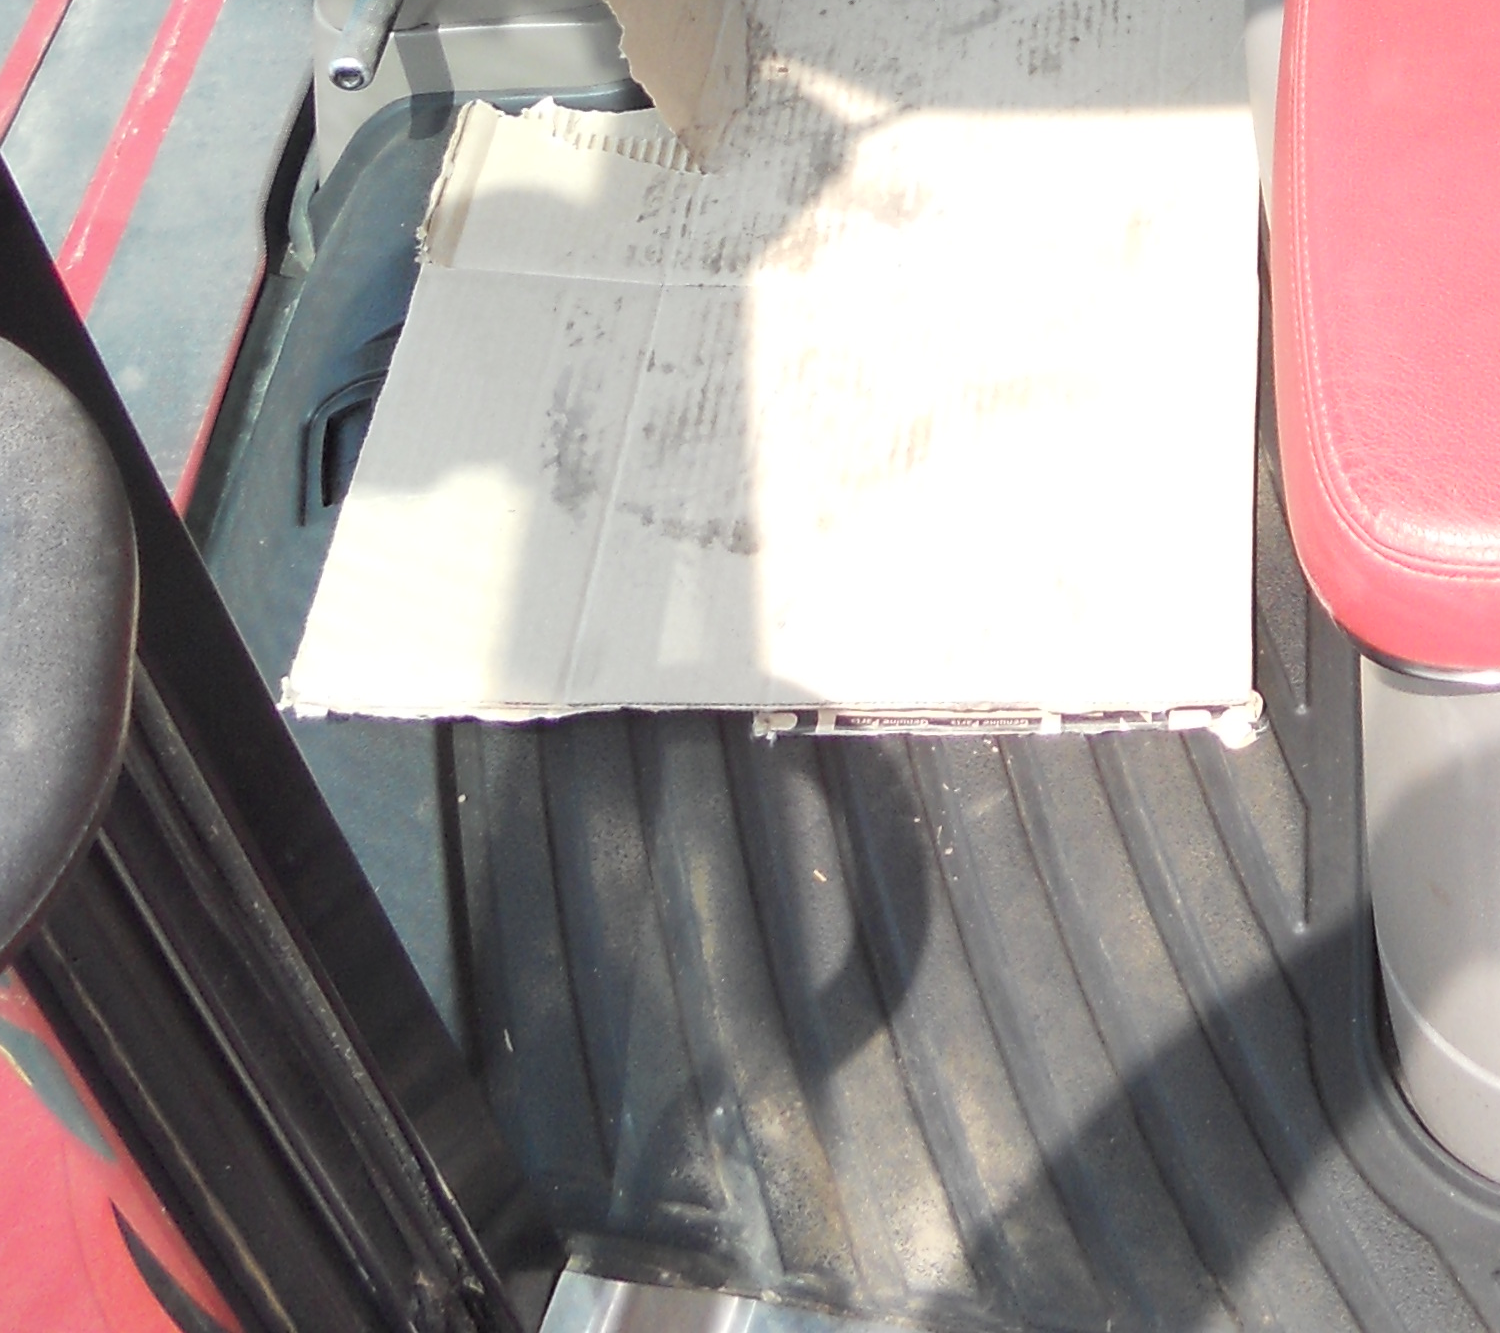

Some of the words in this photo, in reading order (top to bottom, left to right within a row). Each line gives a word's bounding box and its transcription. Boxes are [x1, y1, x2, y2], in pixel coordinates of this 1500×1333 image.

[850, 718, 880, 728] Parts
[883, 718, 929, 728] Genuine
[950, 719, 980, 728] Parts
[982, 719, 1029, 728] Genuine
